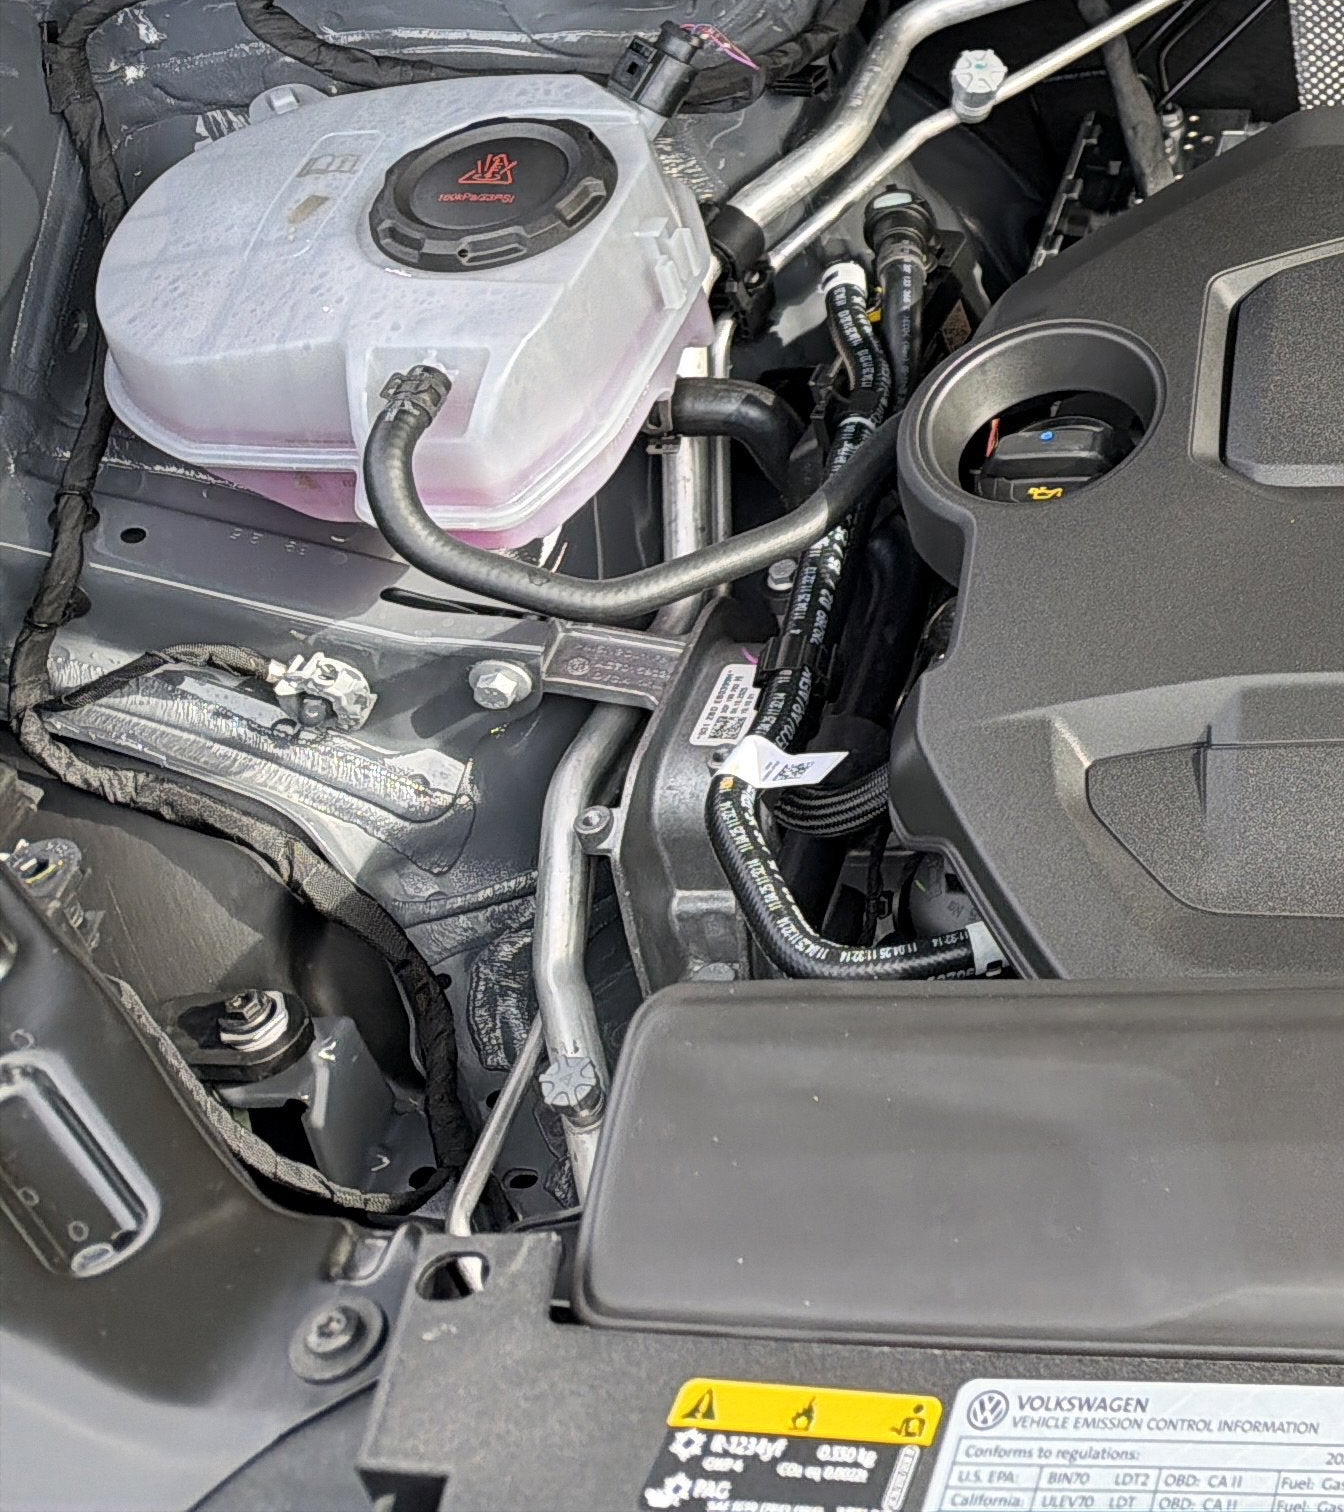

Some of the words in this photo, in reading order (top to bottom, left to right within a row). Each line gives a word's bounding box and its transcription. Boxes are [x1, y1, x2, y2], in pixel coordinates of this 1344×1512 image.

[1017, 1395, 1149, 1413] VOLKSWAGEN
[1012, 1415, 1069, 1430] VEHICLE
[1073, 1416, 1143, 1431] EMISSION
[1146, 1417, 1213, 1432] CONTROL
[1217, 1420, 1320, 1435] INFORMATION
[964, 1444, 1033, 1459] Conforms
[1038, 1446, 1052, 1459] to
[1056, 1446, 1140, 1463] regulations:
[957, 1471, 982, 1483] U.S.
[987, 1471, 1019, 1483] EPA:
[1047, 1472, 1090, 1485] BIN70
[1114, 1473, 1150, 1486] LDT2
[1164, 1474, 1200, 1487] OBD:
[1207, 1475, 1229, 1488] CA
[1281, 1477, 1314, 1490] Fuel:
[950, 1493, 1025, 1508] California:
[1041, 1495, 1095, 1509] ULEV70
[1109, 1496, 1136, 1509] LDT
[1159, 1497, 1195, 1511] OBD:
[1276, 1500, 1310, 1512] Fuel:
